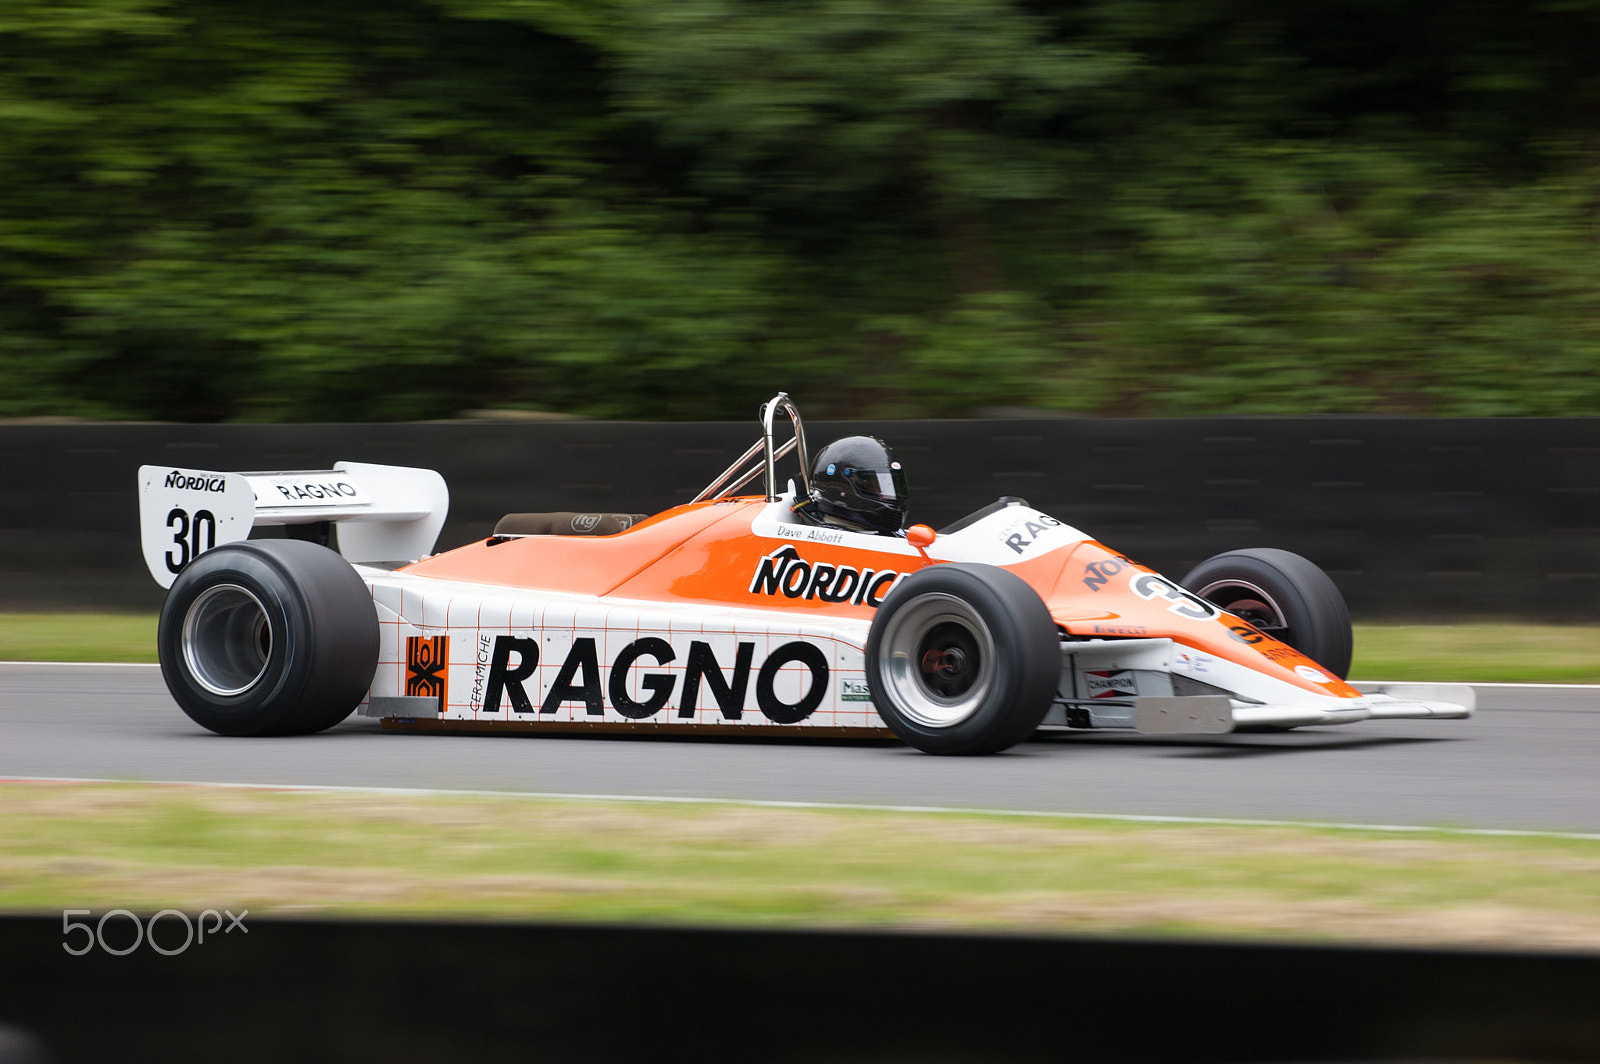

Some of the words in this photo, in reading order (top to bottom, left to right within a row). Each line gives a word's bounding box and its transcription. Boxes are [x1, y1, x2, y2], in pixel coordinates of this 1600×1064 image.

[164, 470, 226, 493] NORDICA
[276, 482, 356, 500] RAGNO
[165, 508, 215, 574] 30
[777, 525, 802, 538] Dave
[807, 530, 843, 544] Abbott
[1005, 515, 1061, 555] RAG
[749, 544, 912, 609] NORDIC
[469, 634, 492, 712] CERAMICHE
[482, 634, 830, 725] RAGNO
[1089, 679, 1135, 690] CHAMPION
